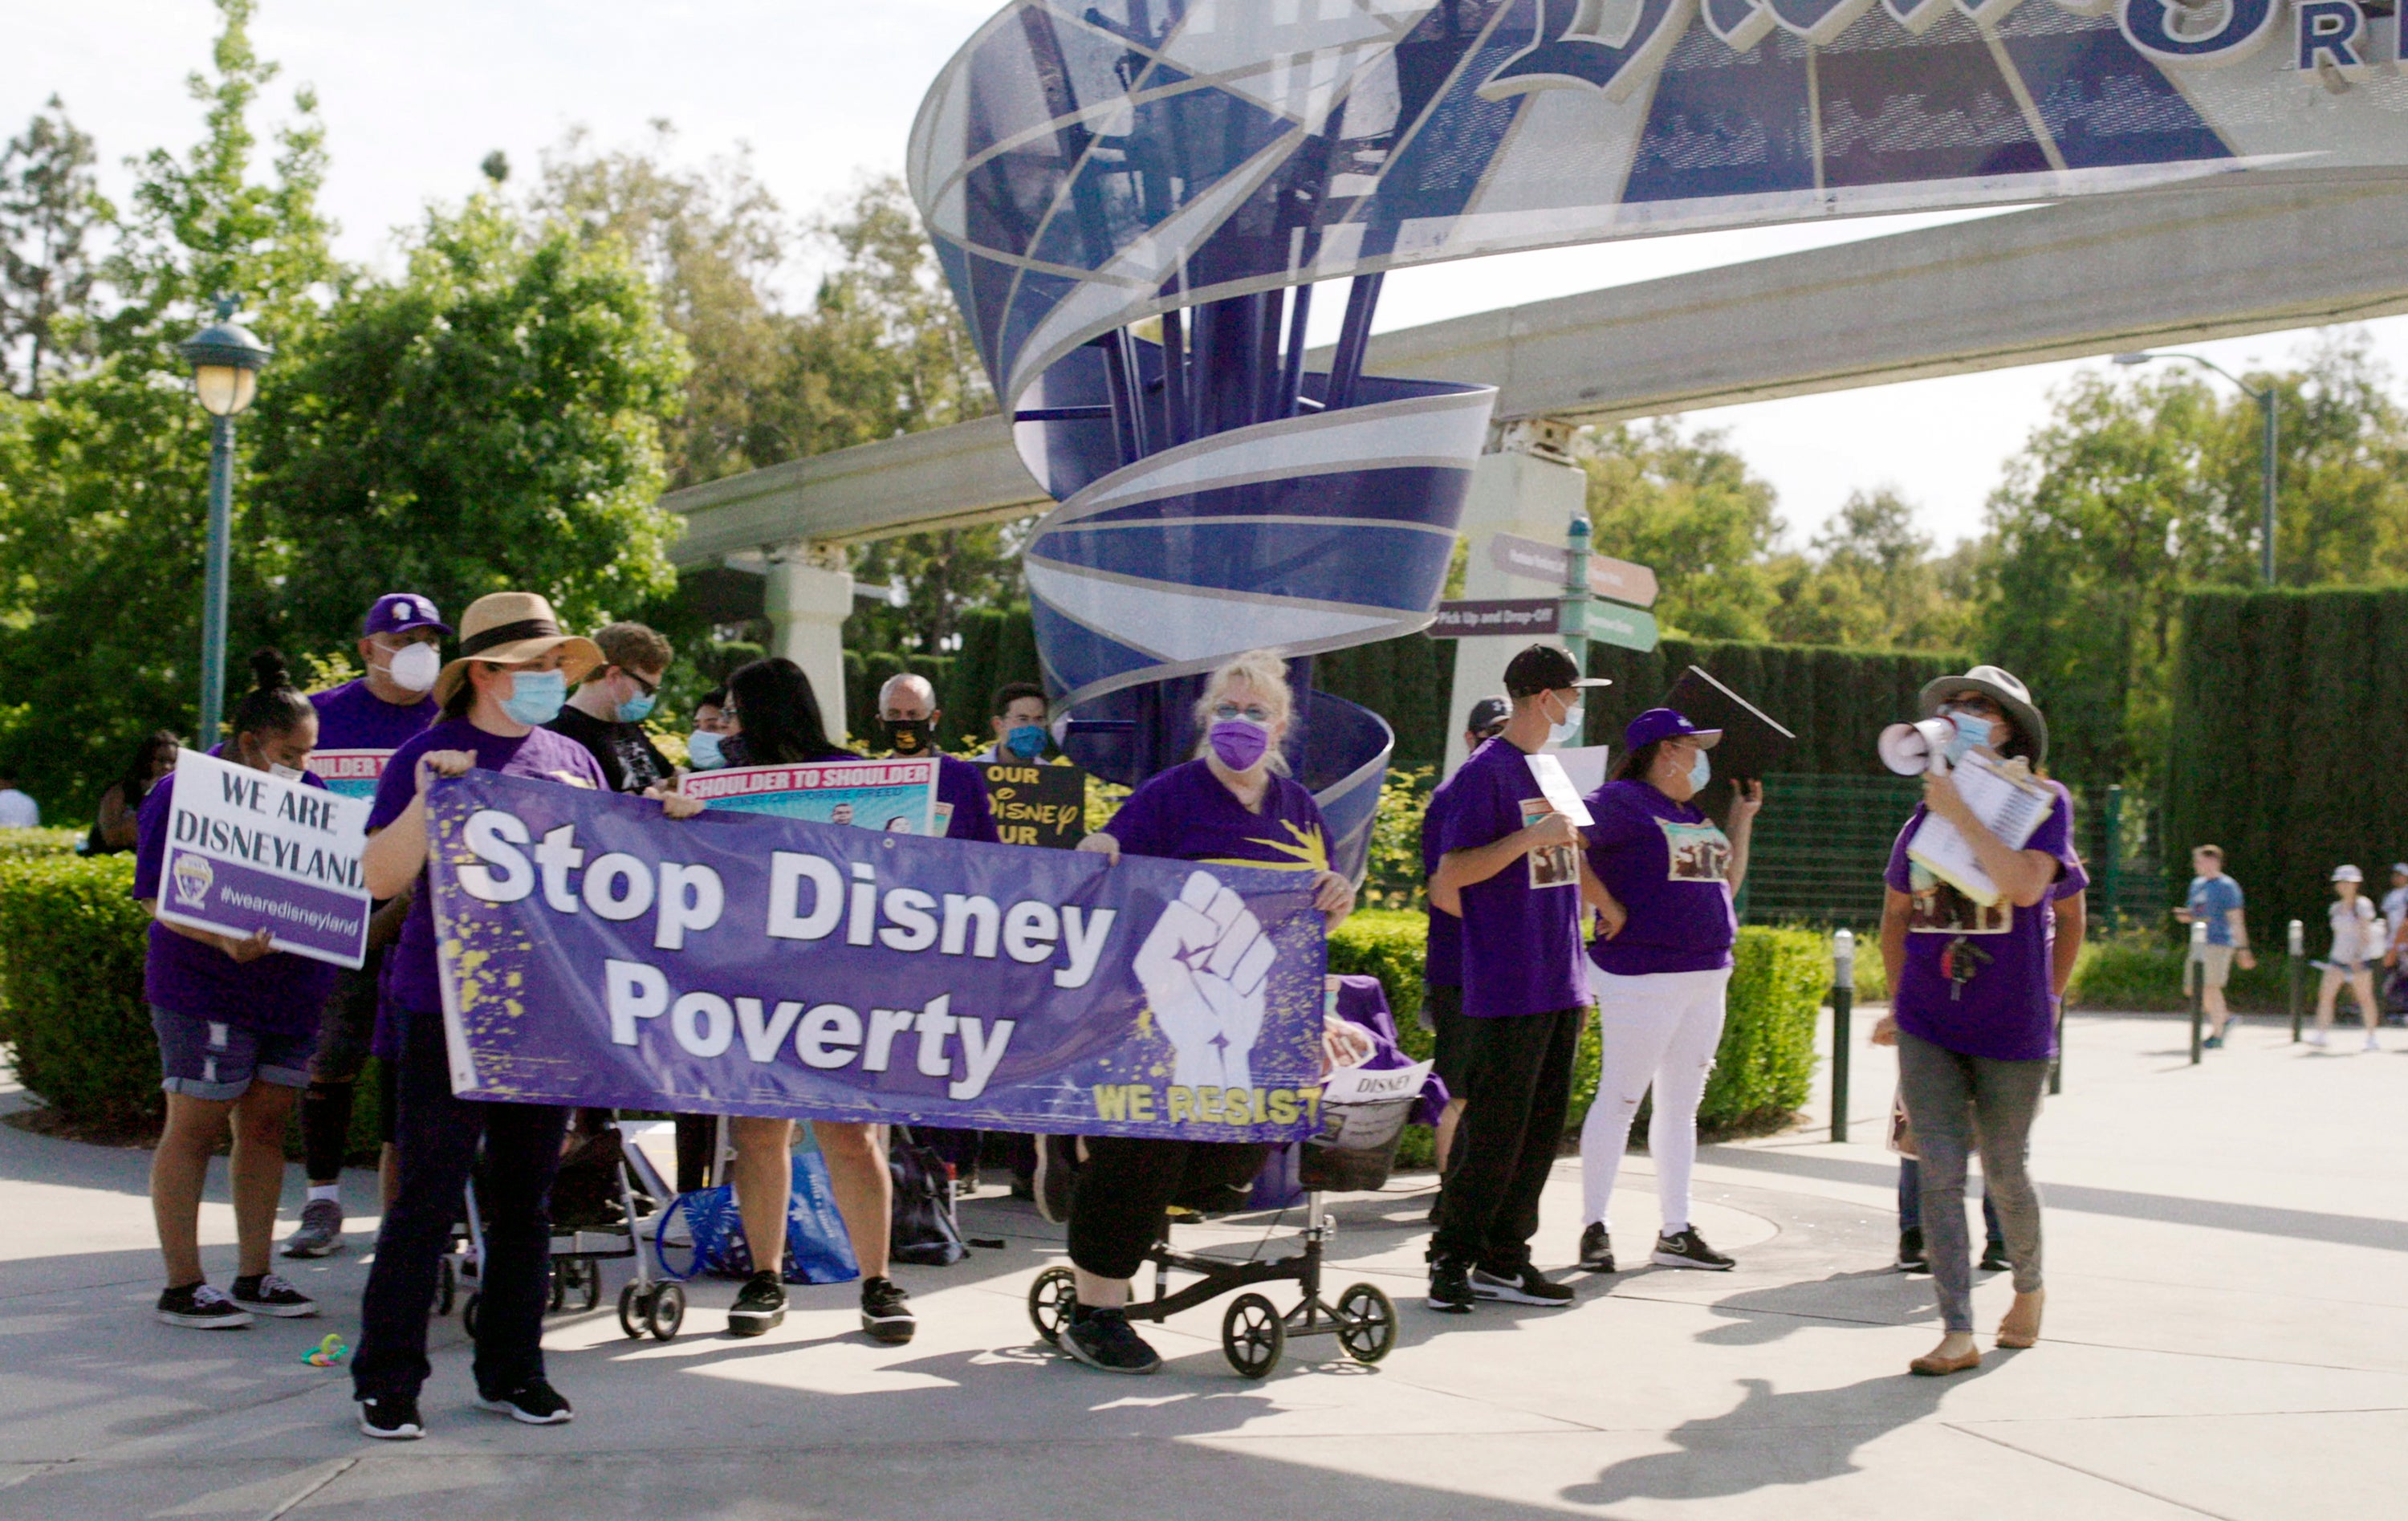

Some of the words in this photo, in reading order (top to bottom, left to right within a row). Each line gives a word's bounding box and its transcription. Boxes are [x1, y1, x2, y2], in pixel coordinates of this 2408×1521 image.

[686, 771, 789, 799] SHOULDER
[792, 770, 821, 788] TO
[821, 765, 929, 787] SHOULDER
[986, 766, 1039, 784] OUR
[222, 771, 266, 815] WE
[277, 789, 340, 835] ARE
[174, 807, 364, 889] DISNEYLAND
[996, 824, 1039, 845] UR
[220, 885, 359, 937] #wearedisneyland
[456, 808, 725, 950] Stop
[767, 850, 1117, 989] Disney
[604, 958, 1015, 1100] Poverty
[1092, 1084, 1157, 1122] WE
[1166, 1084, 1323, 1127] RESIST
